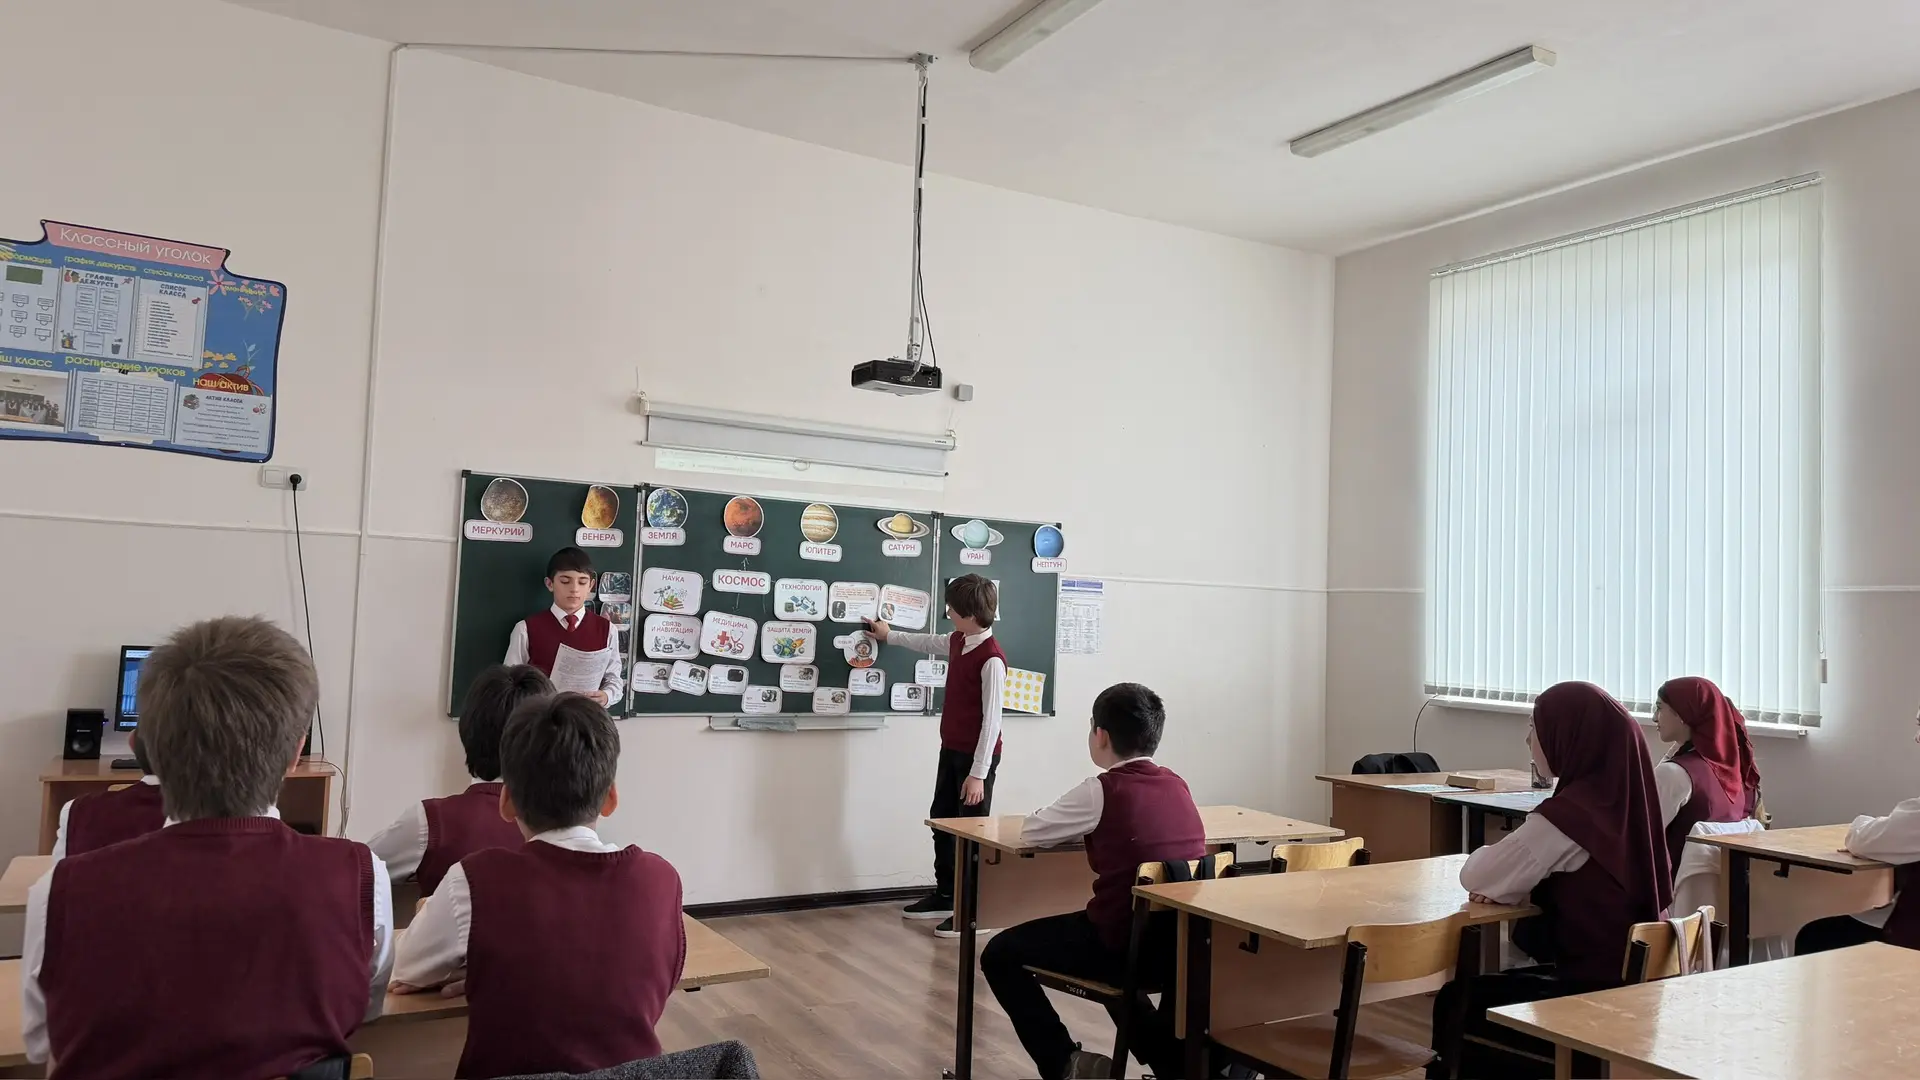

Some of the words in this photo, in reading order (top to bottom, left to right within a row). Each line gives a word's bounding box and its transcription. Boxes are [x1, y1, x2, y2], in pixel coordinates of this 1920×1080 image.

[60, 227, 150, 254] Классный
[156, 245, 212, 264] уголок
[85, 272, 115, 282] ГРАФИК
[143, 267, 173, 277] список
[174, 270, 204, 281] класса
[80, 278, 119, 289] ДЕЖУРСТВ
[160, 283, 187, 292] СПИСОК
[159, 289, 187, 298] КЛАССА
[15, 356, 53, 368] класс
[64, 355, 142, 371] расписание
[145, 365, 186, 377] уроков
[193, 377, 217, 388] наш
[220, 380, 249, 391] актив
[472, 524, 525, 537] МЕРКУРИЙ
[647, 531, 678, 540] ЗЕМЛЯ
[582, 532, 616, 542] ВЕНЕРА
[730, 540, 754, 550] МАРС
[888, 543, 916, 551] САТУРН
[805, 546, 837, 556] ЮПИТЕР
[966, 552, 984, 561] УРАН
[1036, 560, 1063, 569] НЕПТУН
[662, 574, 685, 583] НАУКА
[718, 574, 766, 587] КОСМОС
[781, 583, 822, 591] ТЕХНОЛОГИИ
[712, 616, 749, 630] МЕДИЦИНА
[656, 626, 694, 634] НАВИГАЦИЯ
[767, 626, 791, 634] ЗАЩИТА
[791, 627, 812, 635] ЗЕМЛИ
